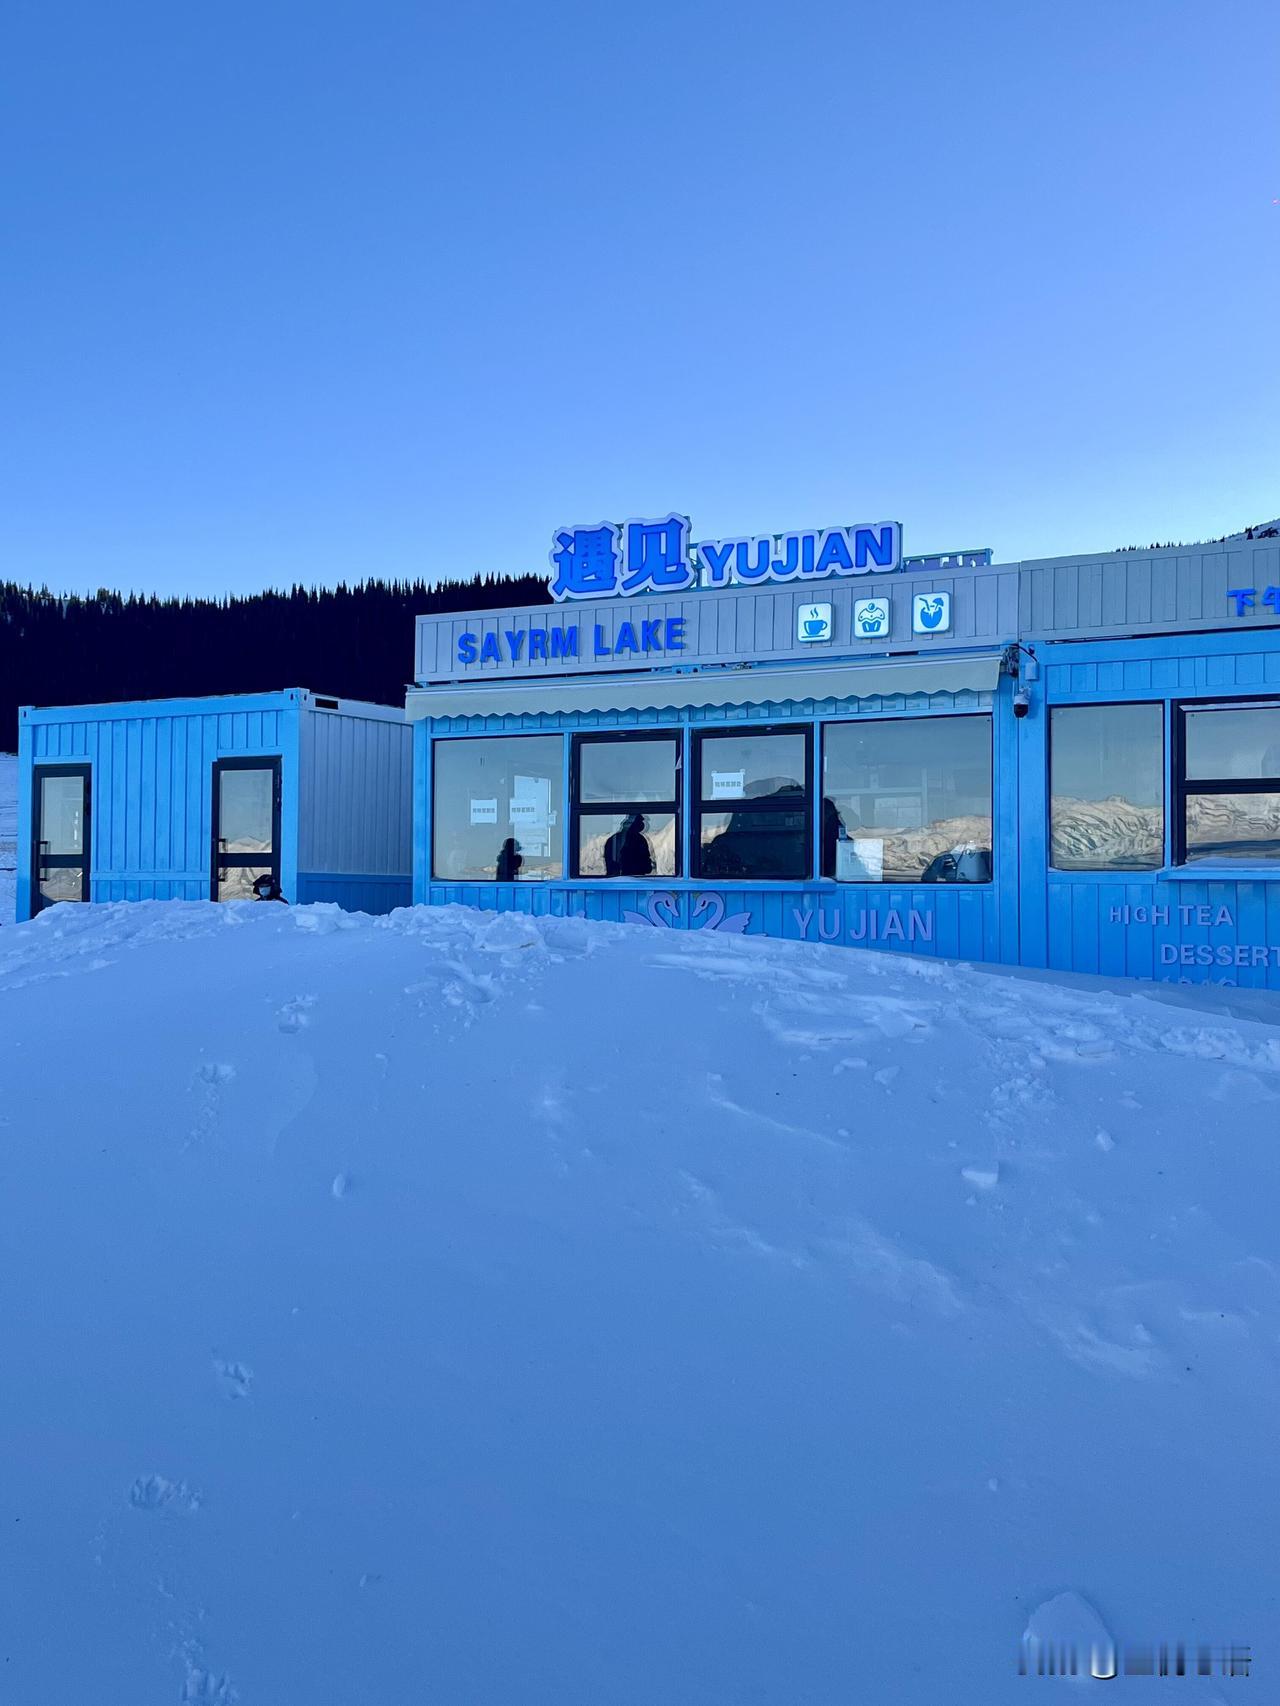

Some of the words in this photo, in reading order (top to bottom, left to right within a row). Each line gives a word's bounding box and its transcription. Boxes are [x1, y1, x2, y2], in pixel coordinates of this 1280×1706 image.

[552, 518, 690, 597] 遇见
[701, 526, 893, 581] YUJIAN
[458, 626, 579, 664] SAYRM
[594, 617, 687, 656] LAKE
[1110, 905, 1170, 926] HIGH
[1178, 905, 1234, 926] TEA
